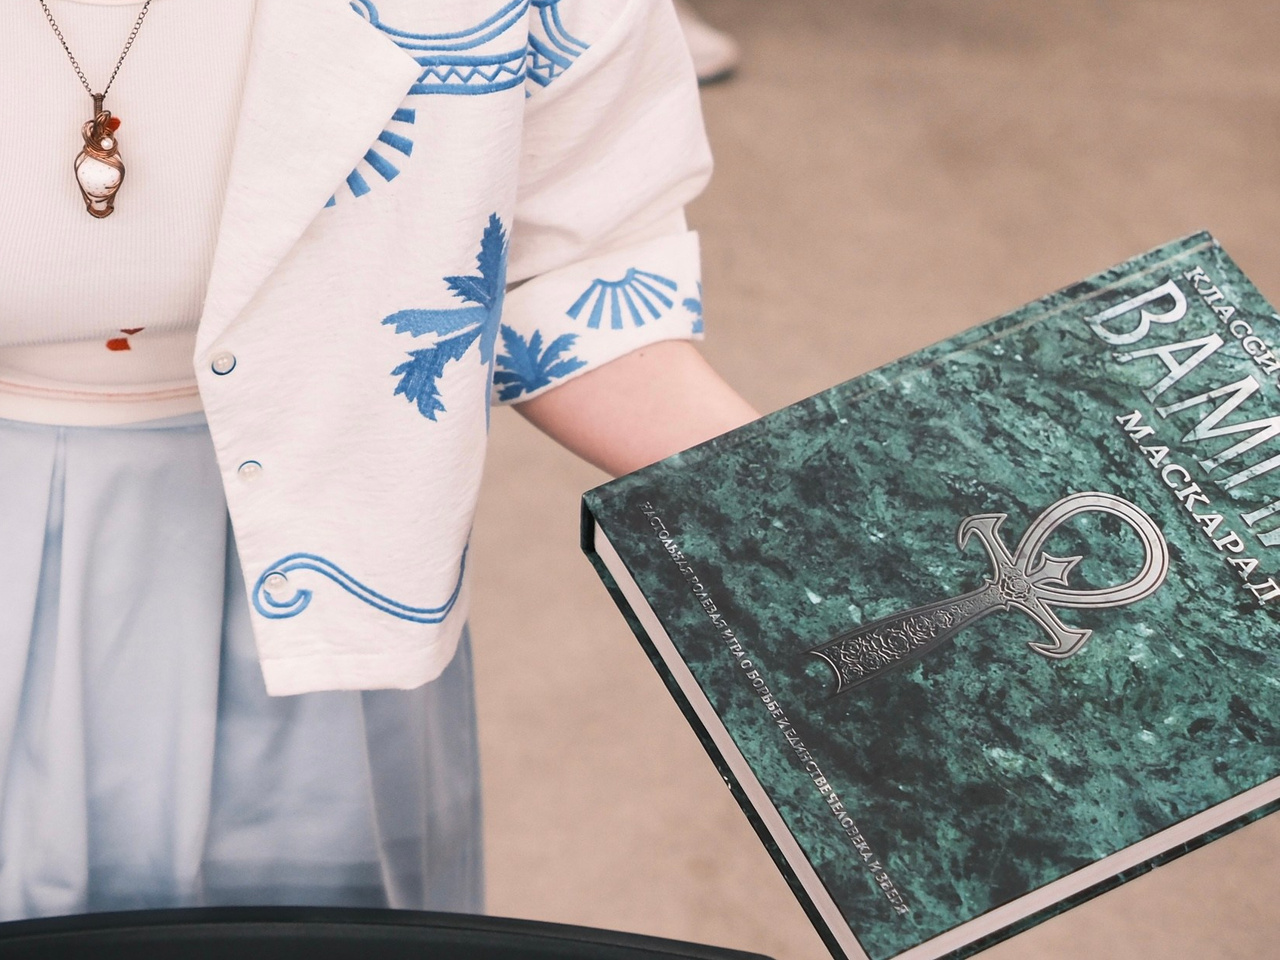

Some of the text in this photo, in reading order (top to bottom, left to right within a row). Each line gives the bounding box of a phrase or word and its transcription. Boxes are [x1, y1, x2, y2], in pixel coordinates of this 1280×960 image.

[1183, 266, 1280, 390] КЛАССИ
[1083, 279, 1280, 547] ВАМ
[1116, 410, 1280, 606] МАСКАРАД
[639, 501, 694, 577] НАСТОЛЬНАЯ
[686, 575, 728, 630] РОЛЕВАЯ
[722, 628, 745, 660] ИГРА
[746, 669, 784, 719] БОРЬБЕ
[776, 717, 791, 730] И
[783, 728, 832, 795] ЕДИНСТВЕ
[826, 792, 874, 863] ЧЕЛОВЕКА
[868, 860, 883, 873] И
[874, 872, 910, 916] ЗВЕРЯ
